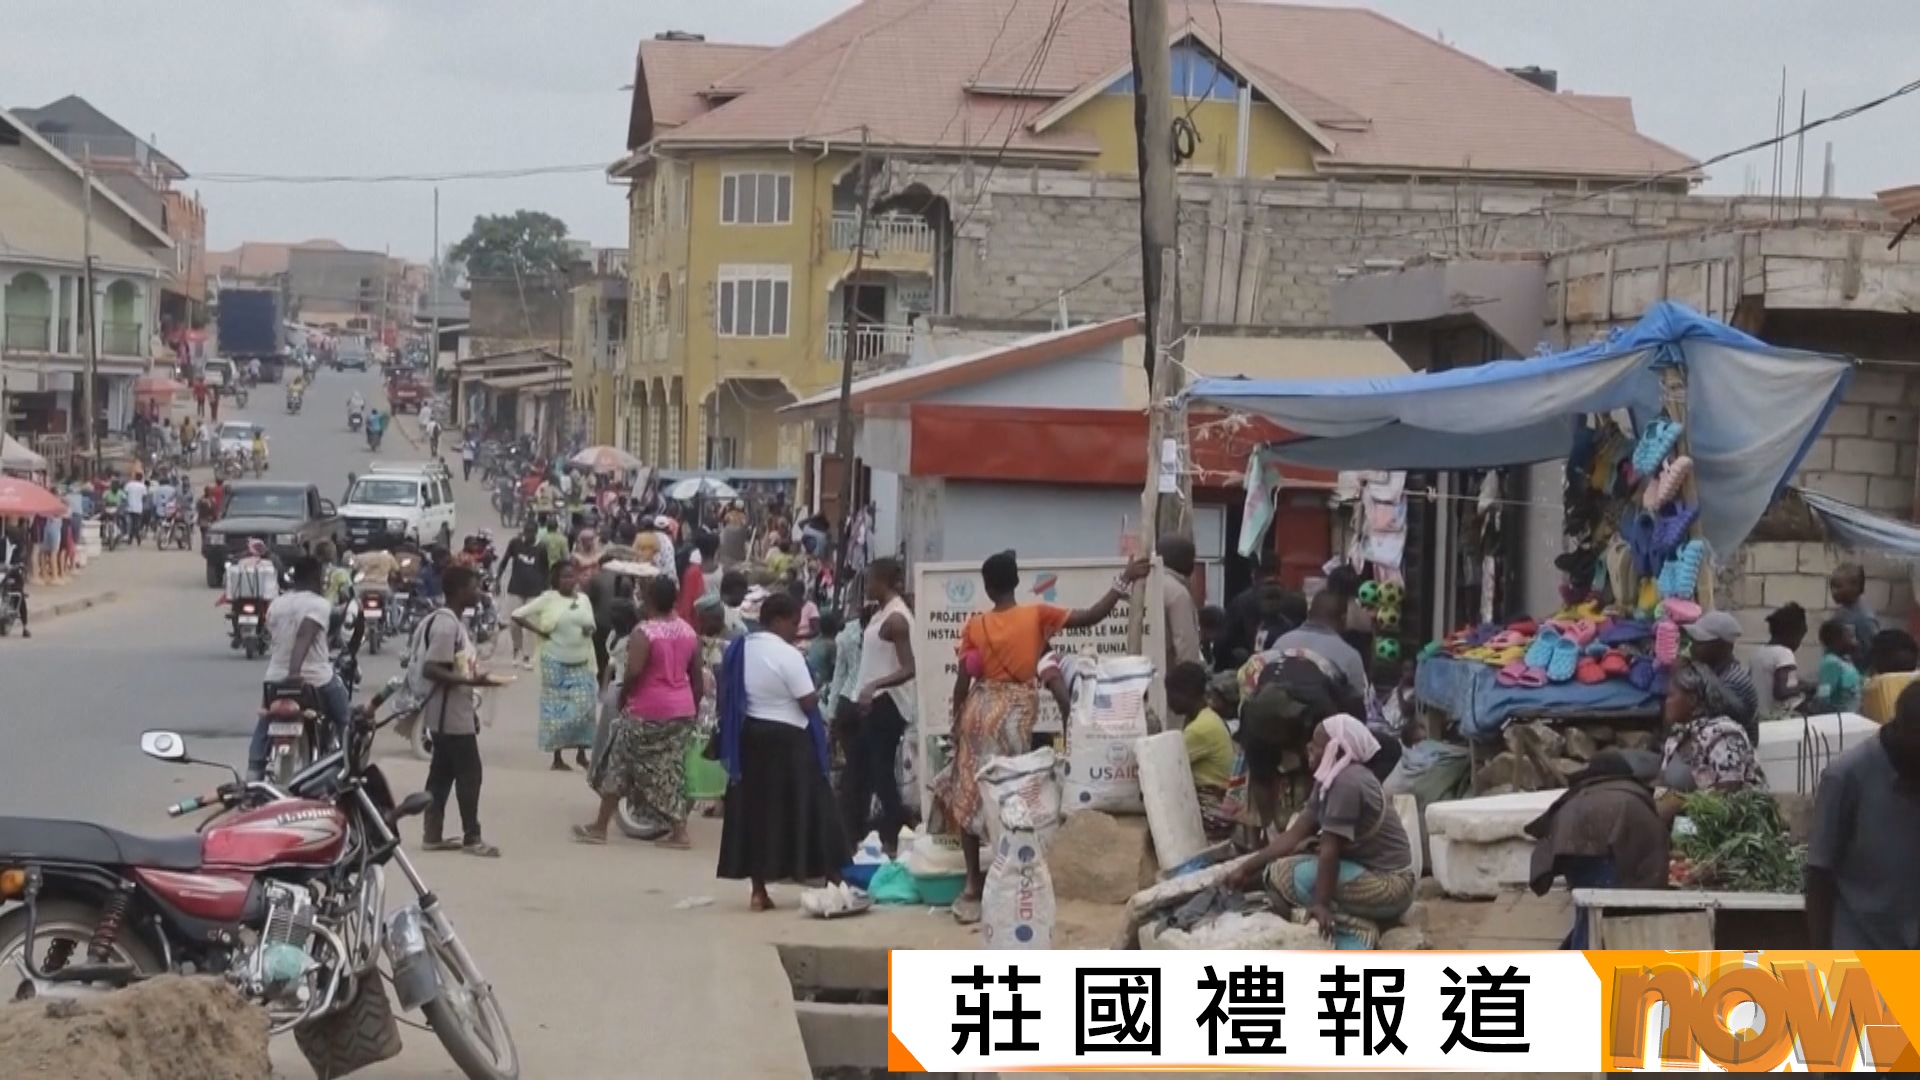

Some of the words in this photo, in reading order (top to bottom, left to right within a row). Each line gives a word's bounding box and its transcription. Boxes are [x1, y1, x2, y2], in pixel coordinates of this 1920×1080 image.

[929, 611, 968, 623] PROJET
[926, 628, 962, 640] INSTAL
[1066, 627, 1092, 637] DANS
[1095, 626, 1107, 637] LE
[1110, 624, 1151, 636] MAE
[1054, 644, 1079, 655] TRAL
[1096, 642, 1127, 655] BUNIA
